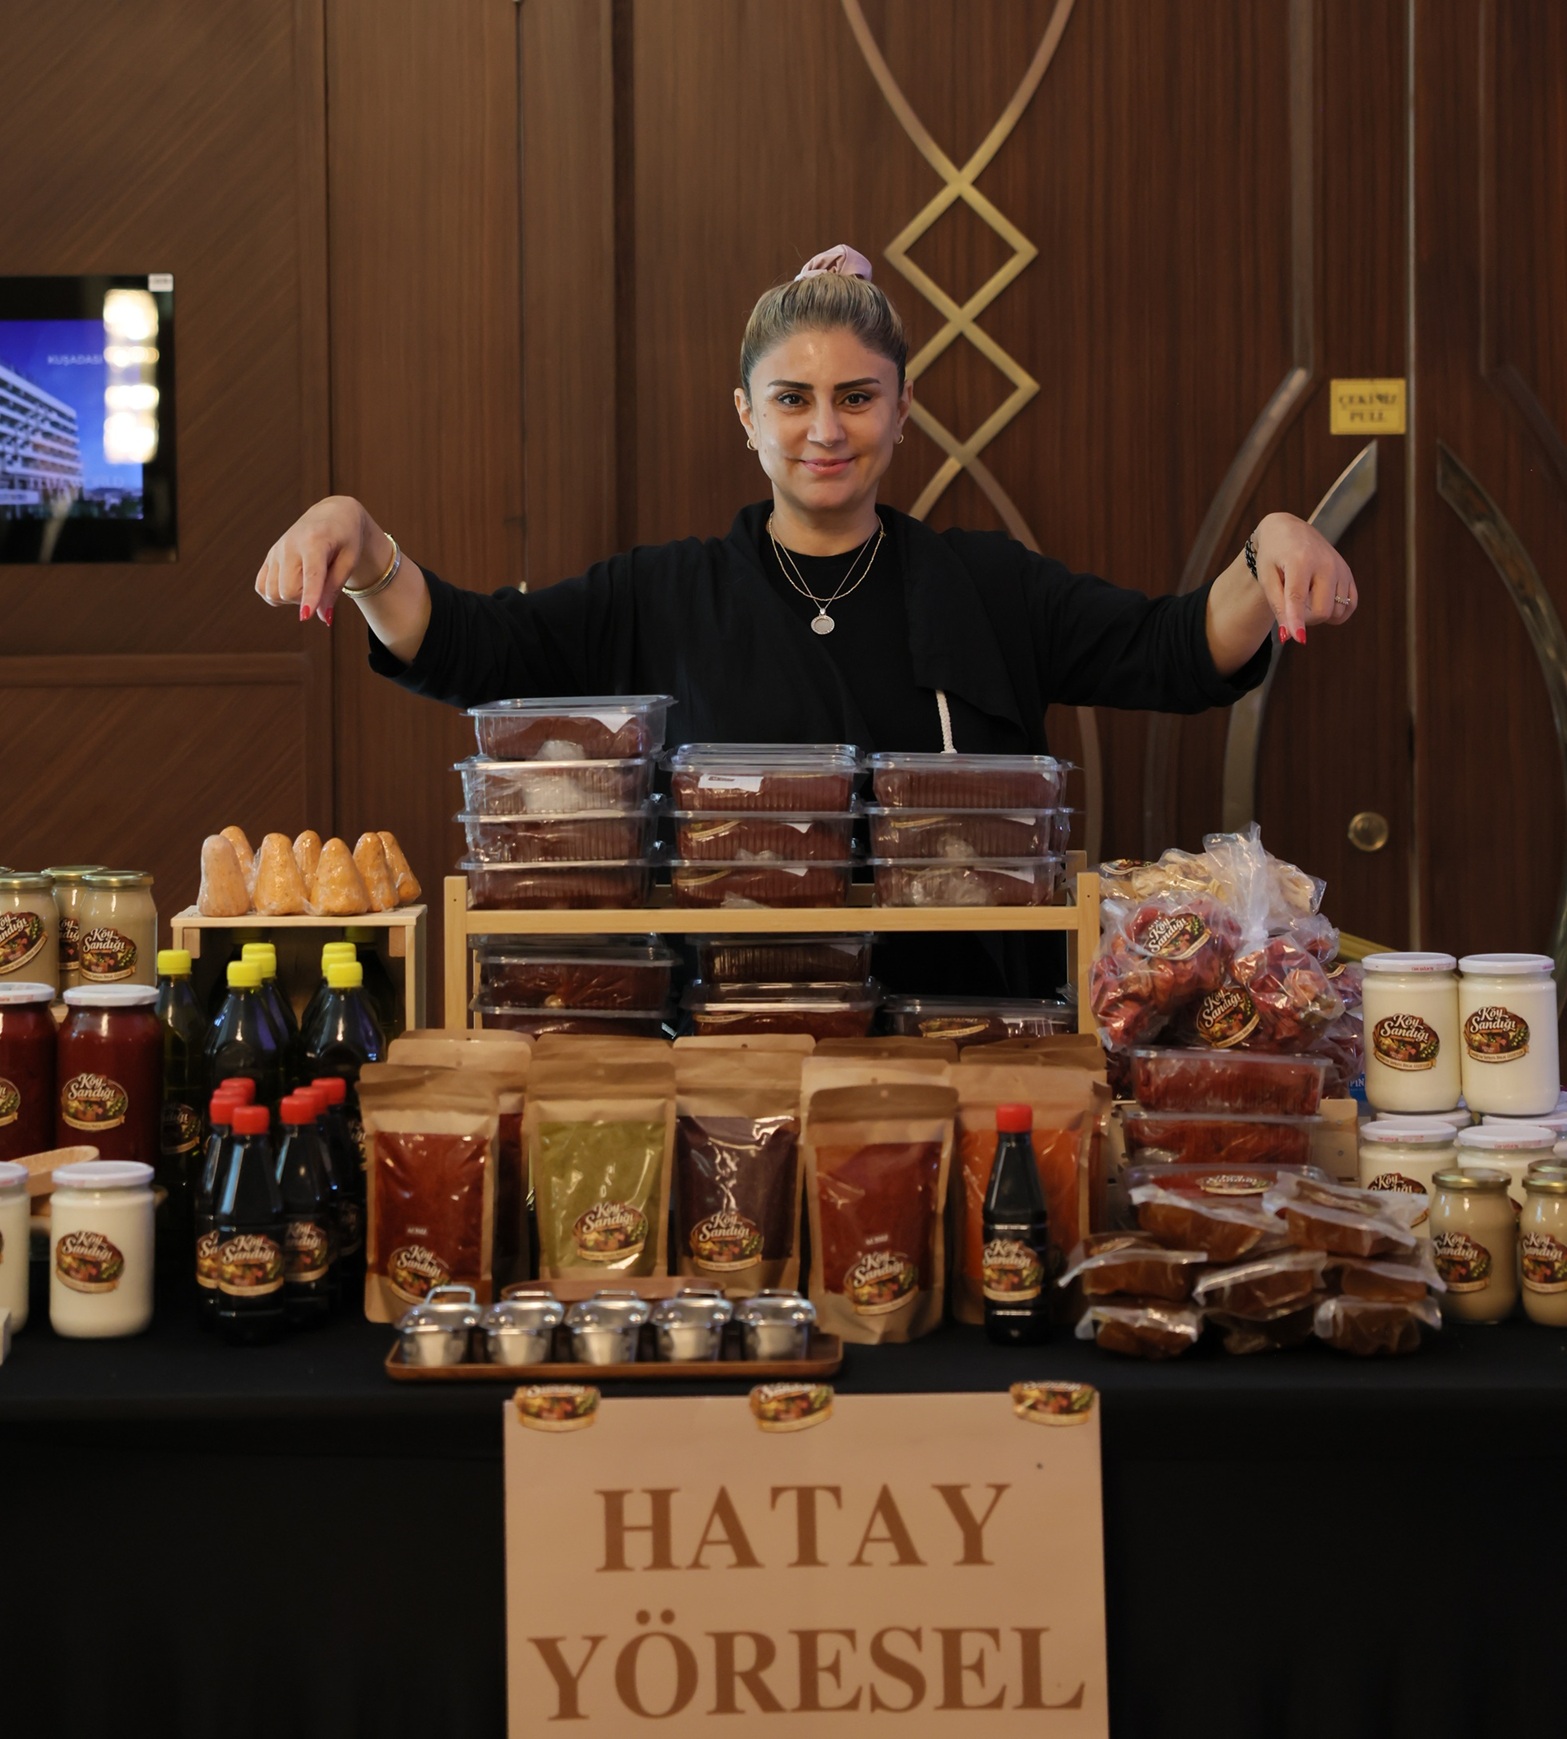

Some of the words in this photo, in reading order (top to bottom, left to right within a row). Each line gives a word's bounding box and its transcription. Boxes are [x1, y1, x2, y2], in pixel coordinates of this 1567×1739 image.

[91, 927, 119, 941] Köy
[83, 937, 126, 952] Sandığı
[1204, 989, 1230, 1011] Köy
[1203, 993, 1243, 1028] Sandığı
[1478, 1006, 1509, 1021] Köy
[1393, 1013, 1423, 1030] Köy
[1470, 1017, 1516, 1034] Sandığı
[1381, 1020, 1429, 1043] Sandığı
[78, 1073, 107, 1089] Köy
[68, 1083, 115, 1099] Sandığı
[1374, 1174, 1405, 1190] Köy
[594, 1202, 625, 1219] Köy
[583, 1212, 634, 1234] Sandığı
[710, 1212, 742, 1228] Köy
[699, 1223, 750, 1242] Sandığı
[594, 1483, 1012, 1573] HATAY
[527, 1608, 1086, 1722] YÖRESEL
